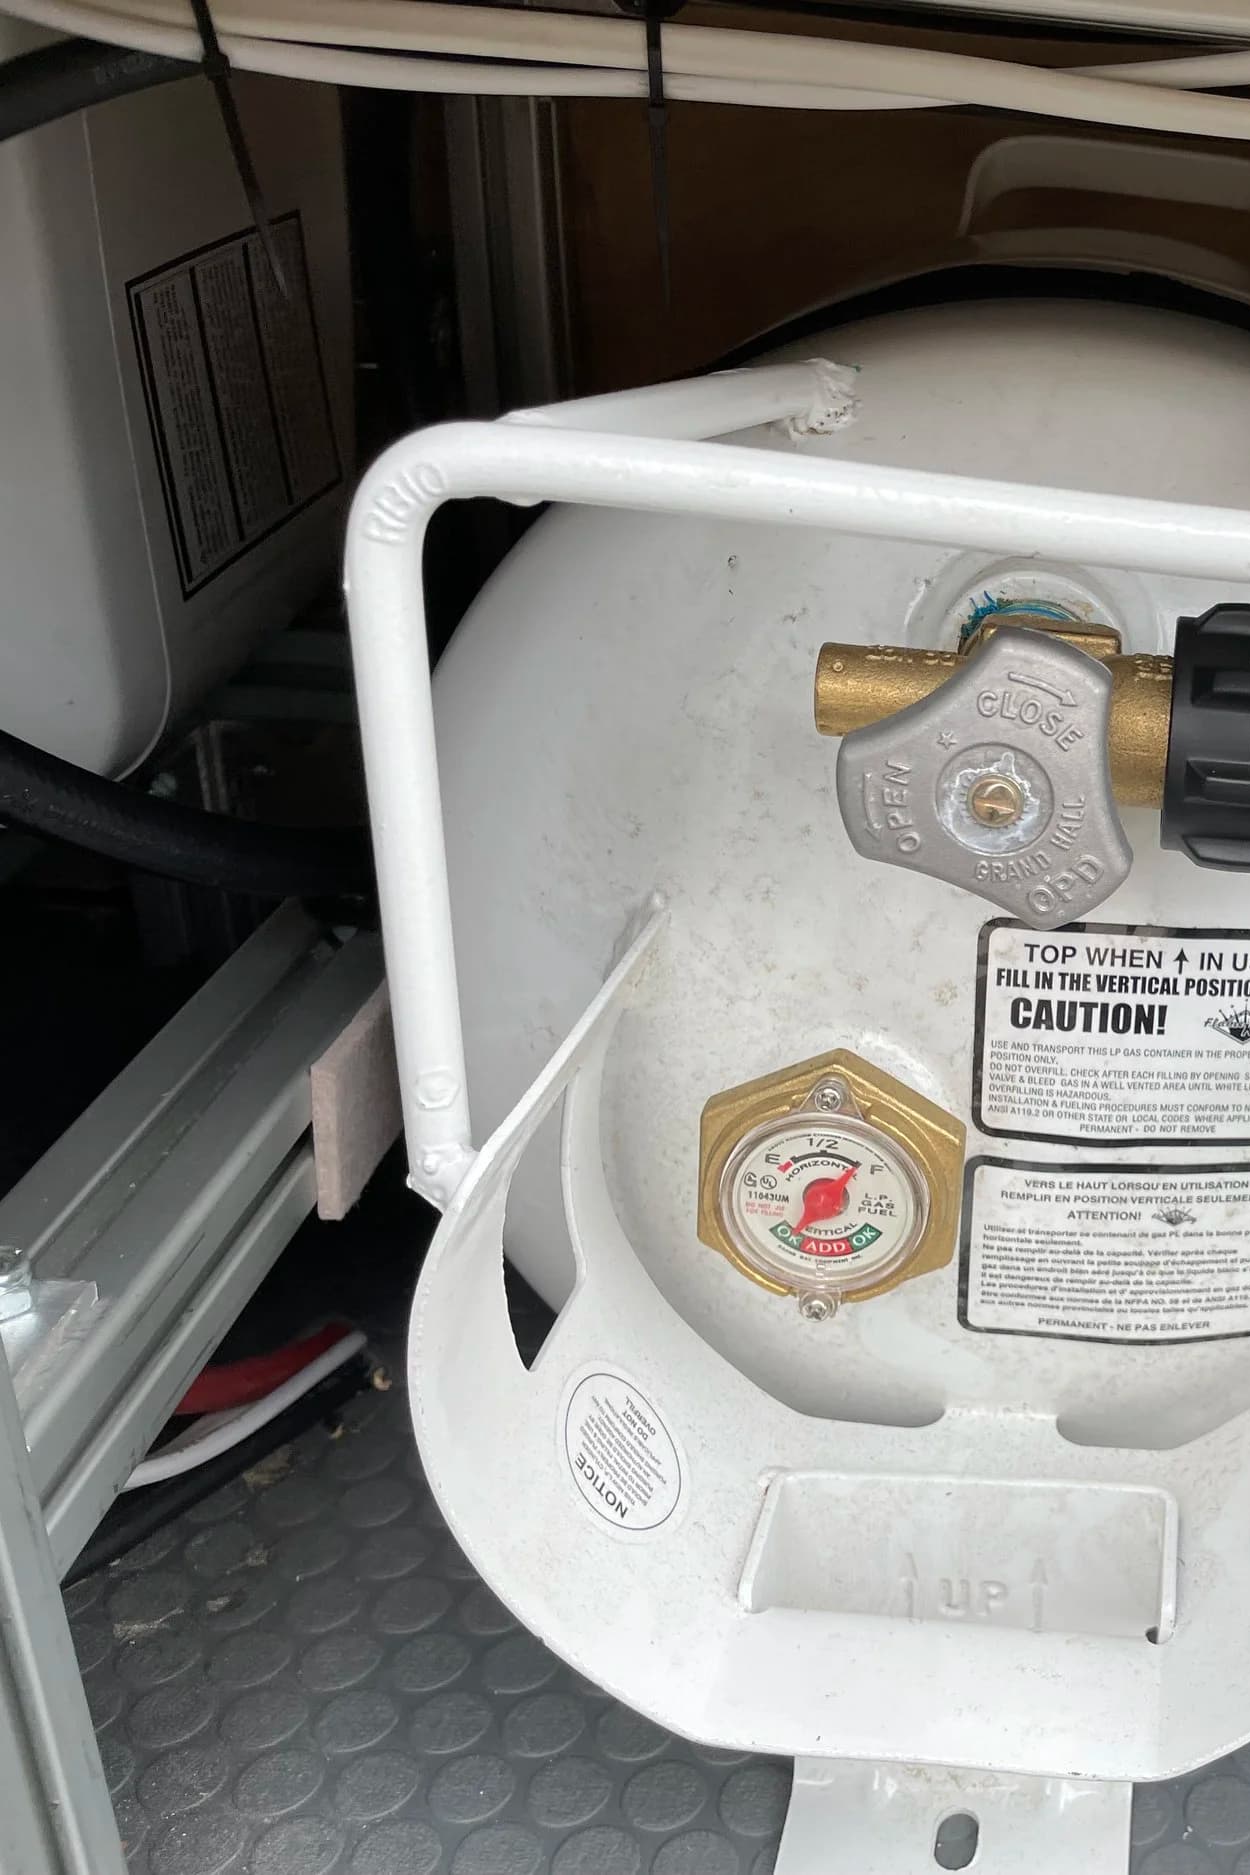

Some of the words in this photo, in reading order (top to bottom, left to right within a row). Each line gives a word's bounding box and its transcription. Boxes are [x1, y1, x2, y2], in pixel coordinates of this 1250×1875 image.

[977, 690, 1084, 752] CLOSE
[882, 759, 922, 854] OPEN
[973, 852, 1052, 882] GRAND
[1050, 796, 1084, 852] HALL
[1026, 853, 1105, 914] OPD
[1024, 944, 1076, 964] TOP
[1086, 946, 1162, 969] WHEN
[1200, 952, 1223, 971] IN
[996, 968, 1030, 988] FILL
[1035, 971, 1053, 990] IN
[1059, 972, 1091, 992] THE
[1096, 974, 1179, 996] VERTICAL
[1010, 997, 1167, 1035] CAUTION!
[991, 1040, 1008, 1049] USE
[1011, 1042, 1030, 1051] AND
[1032, 1043, 1086, 1055] TRANSPORT
[1088, 1046, 1108, 1056] THIS
[1110, 1048, 1121, 1056] LP
[1123, 1048, 1141, 1057] GAS
[1144, 1049, 1192, 1058] CONTAINER
[1206, 1050, 1222, 1058] THE
[991, 1051, 1032, 1062] POSITION
[990, 1062, 1002, 1071] DO
[1004, 1063, 1022, 1073] NOT
[1070, 1068, 1100, 1078] CHECK
[1101, 1069, 1129, 1079] AFTER
[1131, 1071, 1154, 1080] EACH
[1157, 1071, 1188, 1080] FILLING
[1190, 1072, 1201, 1080] BY
[1203, 1072, 1240, 1080] OPENING
[989, 1072, 1018, 1083] VALVE
[1028, 1076, 1056, 1086] BLEED
[1060, 1078, 1079, 1088] GAS
[1101, 1081, 1124, 1090] WELL
[1127, 1081, 1161, 1090] VENTED
[1163, 1082, 1186, 1091] AREA
[1188, 1082, 1212, 1091] UNTIL
[1215, 1082, 1242, 1091] WHITE
[989, 1084, 1044, 1096] OVERFILLING
[1056, 1089, 1112, 1102] HAZARDOUS.
[989, 1093, 1049, 1107] INSTALLATION
[1060, 1100, 1097, 1110] FUELING
[1099, 1103, 1157, 1112] PROCEDURES
[1160, 1104, 1184, 1112] MUST
[1186, 1104, 1229, 1112] CONFORM
[1232, 1104, 1242, 1112] TO
[1042, 1109, 1054, 1118] OR
[1057, 1111, 1086, 1120] OTHER
[1088, 1112, 1113, 1121] STATE
[1115, 1113, 1128, 1122] OR
[1132, 1114, 1158, 1123] LOCAL
[1161, 1114, 1190, 1123] CODES
[1194, 1114, 1224, 1123] WHERE
[1080, 1124, 1133, 1133] PERMANENT
[1144, 1124, 1156, 1133] DO
[1160, 1125, 1178, 1133] NOT
[1180, 1125, 1216, 1133] REMOVE
[808, 1138, 839, 1150] 1/2
[764, 1153, 781, 1165] E
[785, 1160, 858, 1182] HORIZONTL
[870, 1164, 884, 1175] F
[1024, 1180, 1055, 1188] VERS
[1076, 1181, 1108, 1190] HAUT
[1181, 1181, 1249, 1190] UTILISATION
[861, 1200, 895, 1210] GAS
[864, 1192, 893, 1202] L.P.
[1001, 1191, 1052, 1202] REMPLIR
[1055, 1195, 1070, 1203] EN
[1074, 1195, 1127, 1204] POSITION
[1131, 1196, 1193, 1204] VERTICALE
[858, 1206, 897, 1218] FUEL
[1067, 1210, 1141, 1220] ATTENTION!
[777, 1226, 802, 1245] OK
[805, 1220, 858, 1236] ERTICAL
[853, 1228, 876, 1245] OK
[805, 1241, 846, 1253] ADD
[1038, 1317, 1108, 1330] PERMANENT
[1160, 1321, 1210, 1331] ENLEVER
[622, 1411, 637, 1427] NOT
[626, 1396, 656, 1436] OVERFILL
[637, 1426, 648, 1441] DO
[575, 1454, 628, 1518] NOTICE
[938, 1577, 1009, 1617] UP
